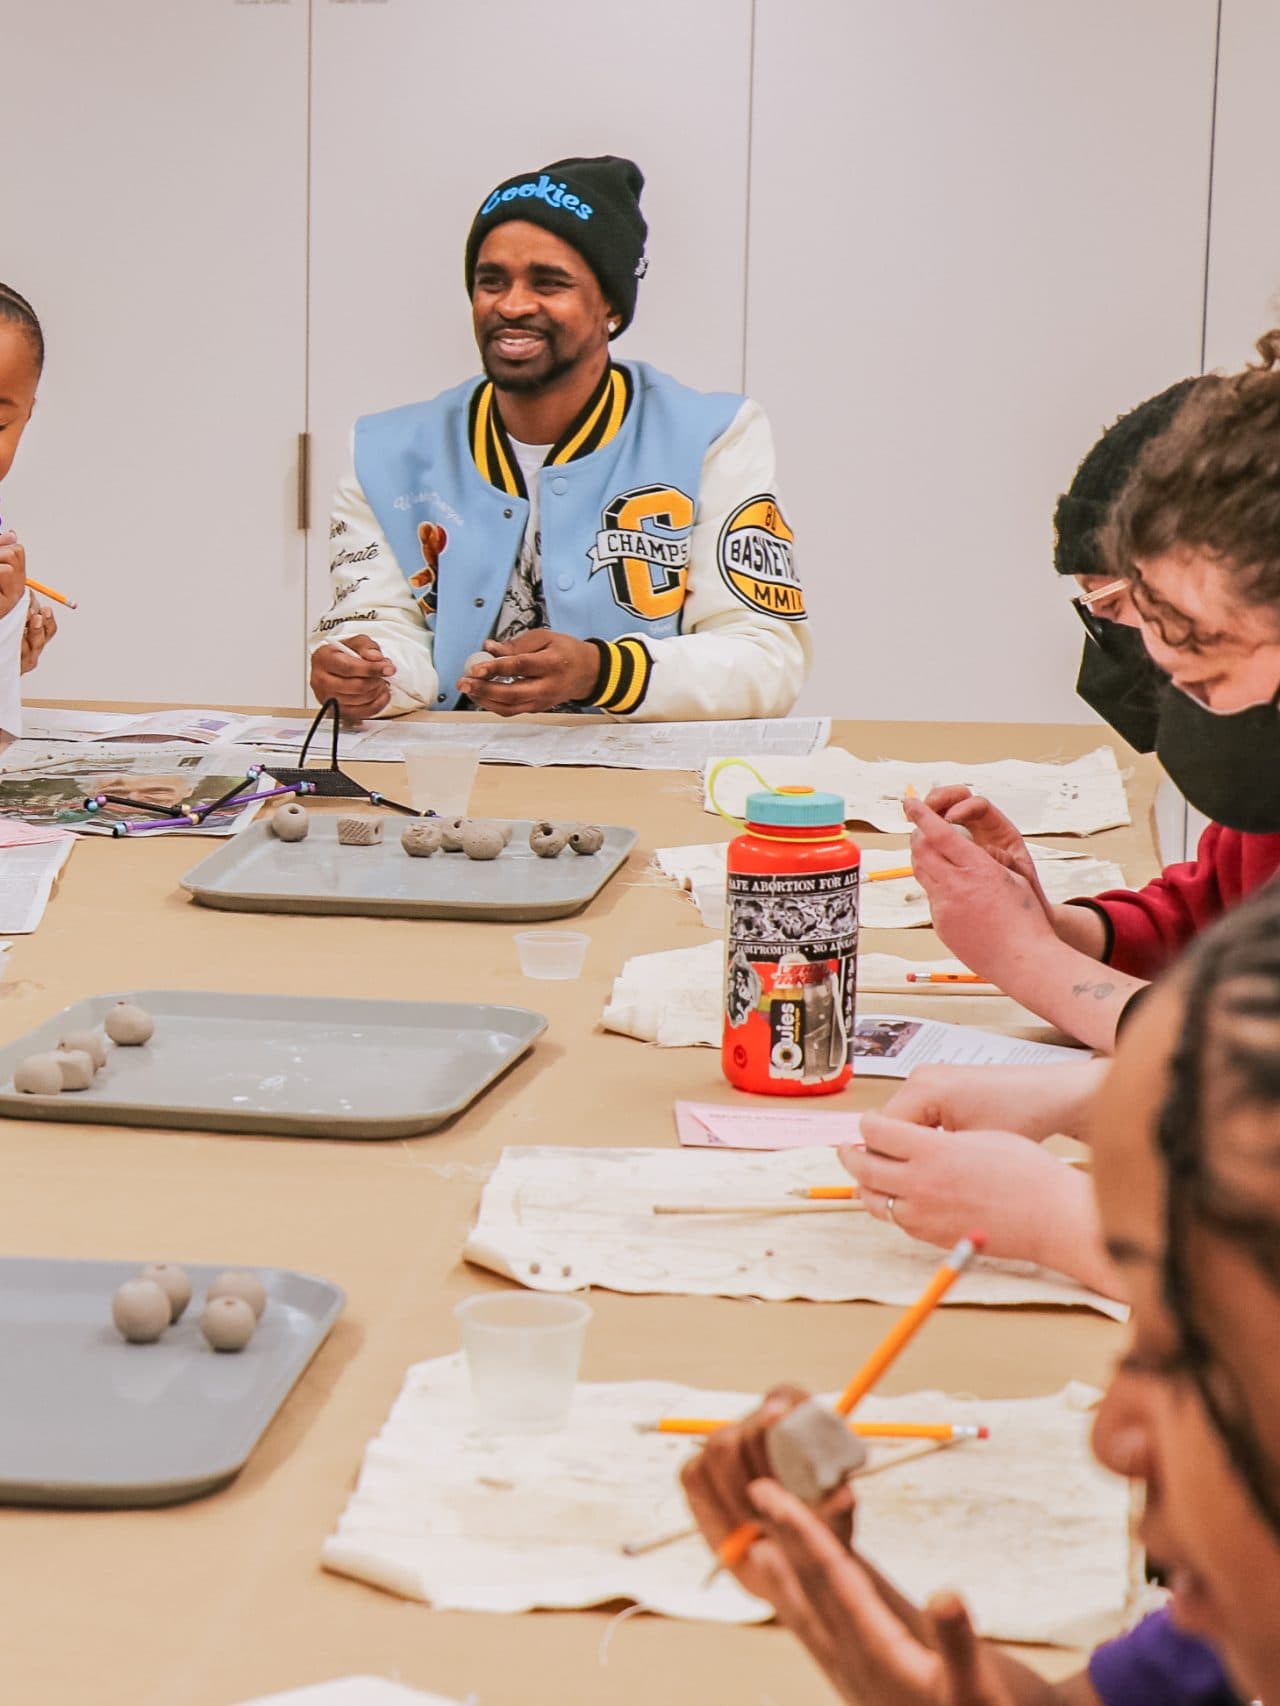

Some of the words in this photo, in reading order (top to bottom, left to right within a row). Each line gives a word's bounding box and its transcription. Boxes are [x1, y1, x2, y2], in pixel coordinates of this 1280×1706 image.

[481, 175, 594, 220] Cookies
[607, 533, 688, 562] CHAMPS
[751, 879, 816, 892] ABORTION
[819, 876, 841, 889] FOR
[812, 943, 828, 954] NO
